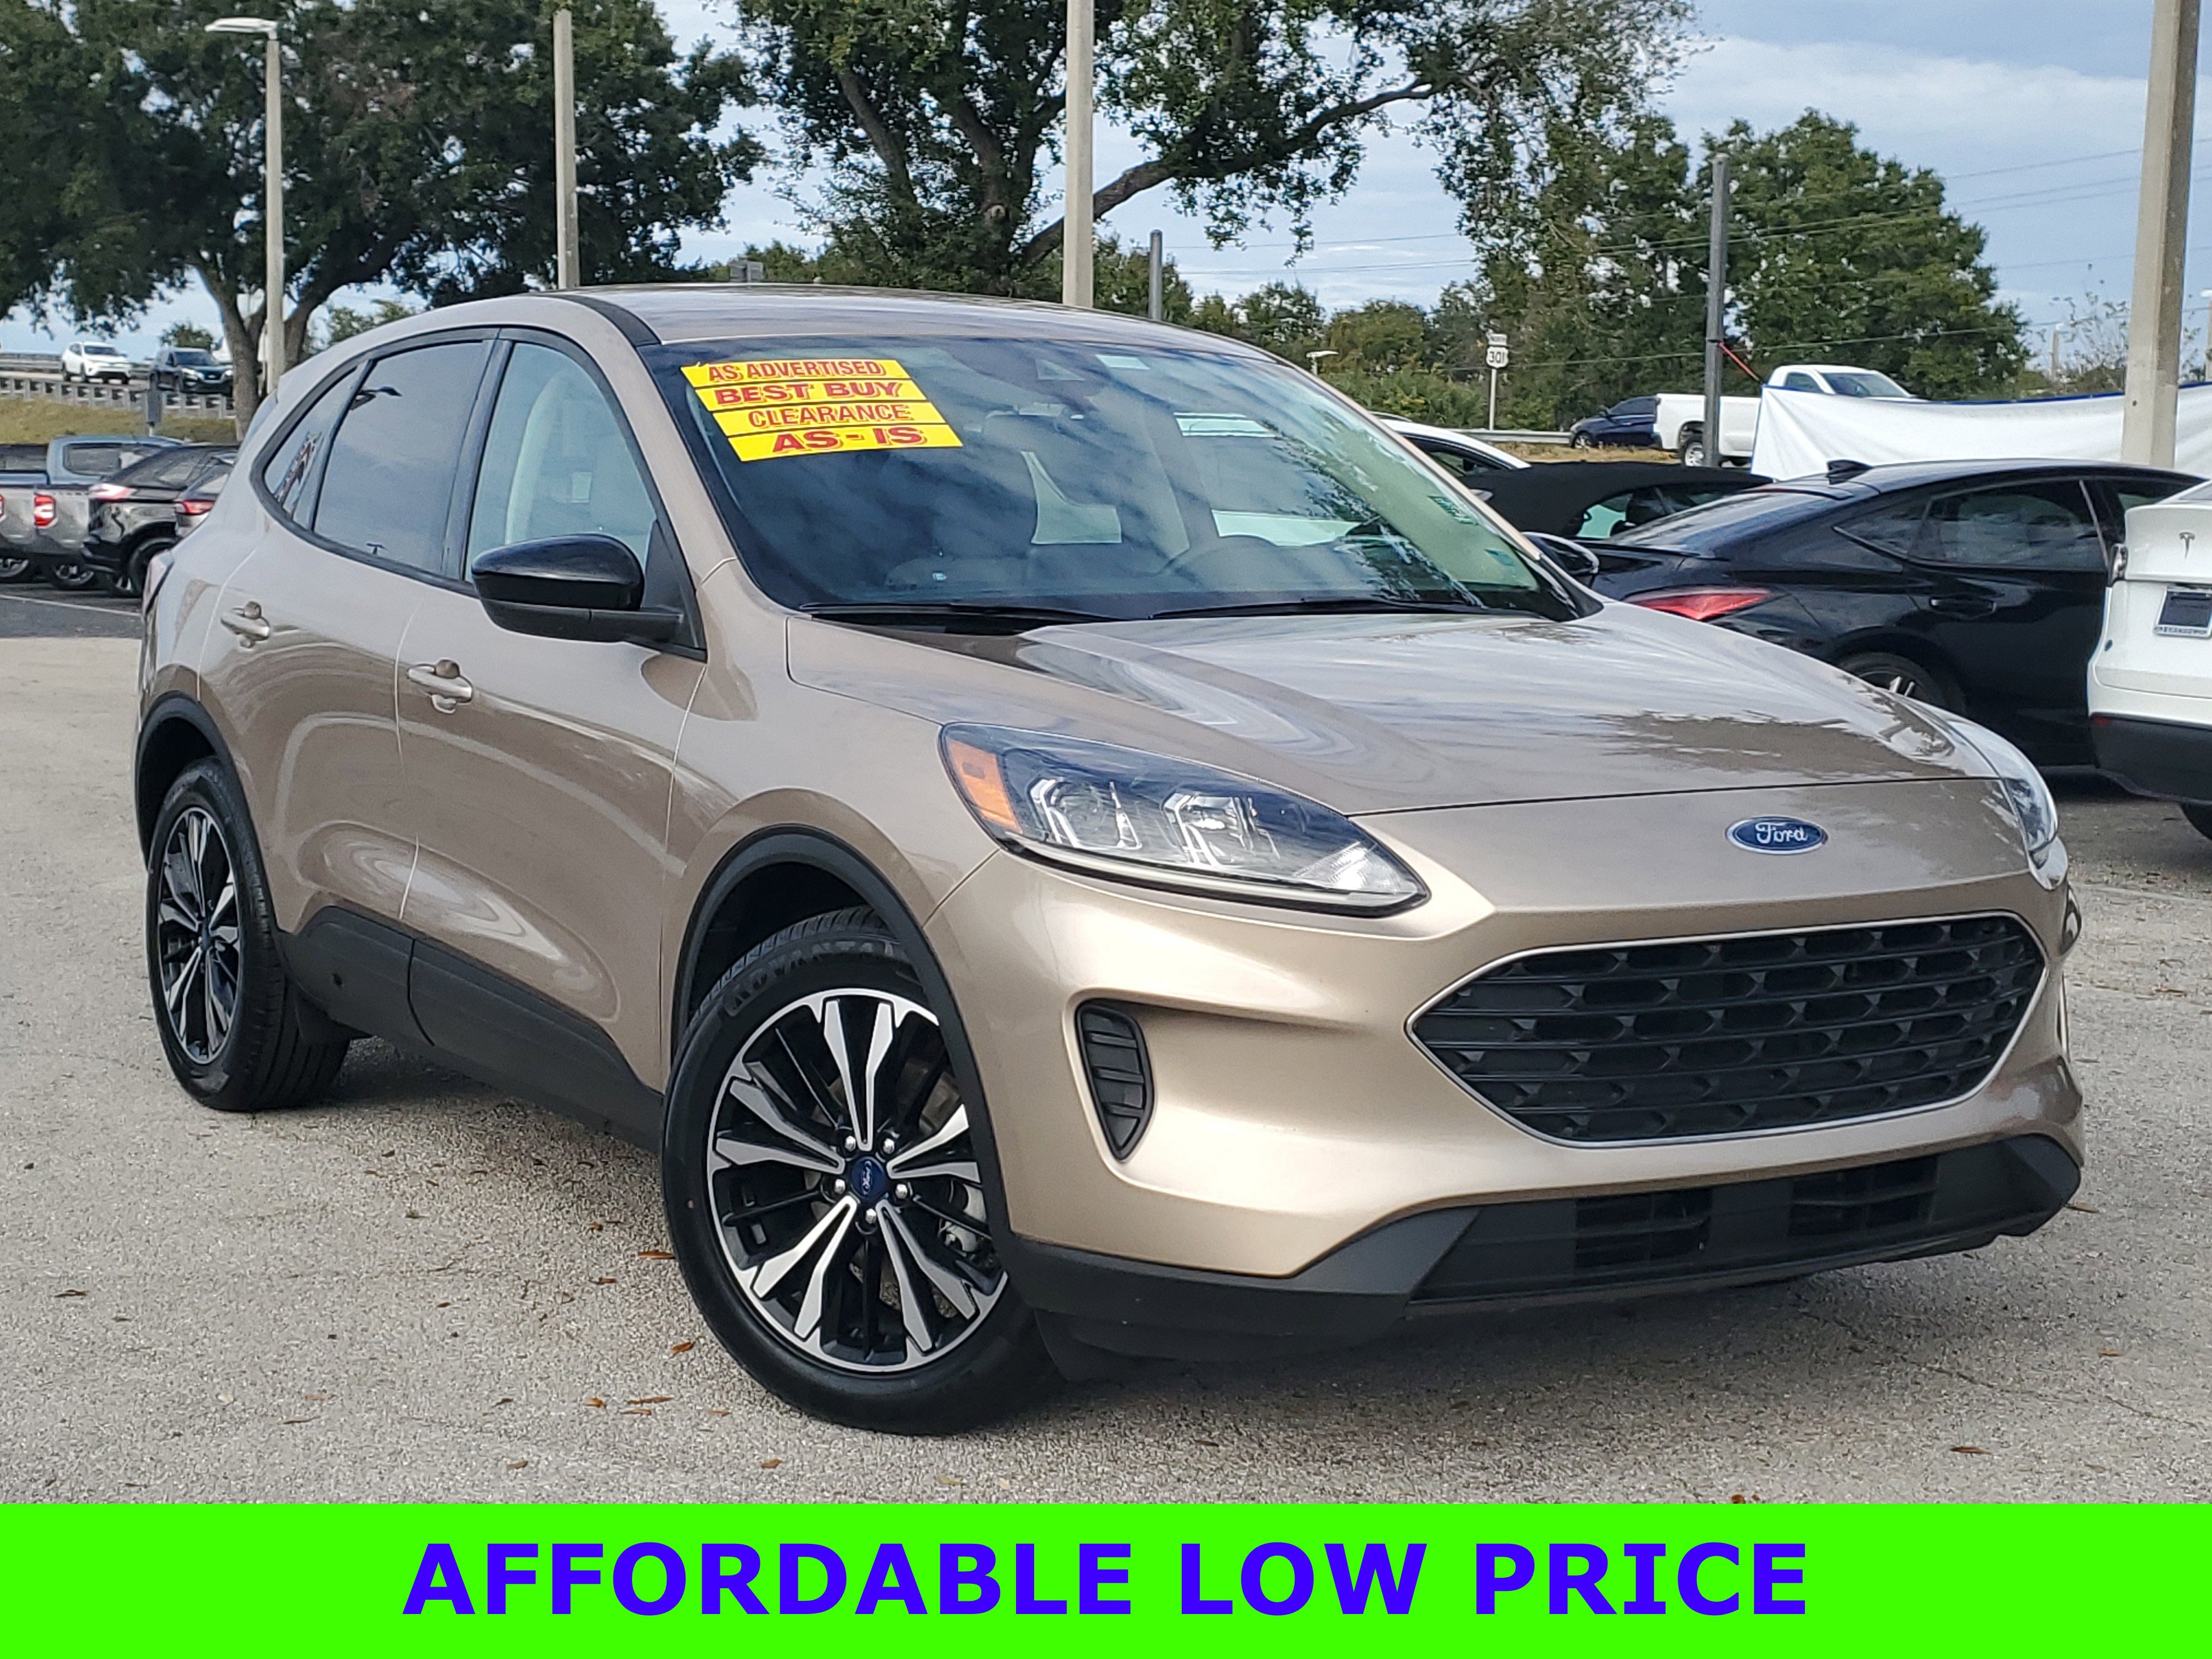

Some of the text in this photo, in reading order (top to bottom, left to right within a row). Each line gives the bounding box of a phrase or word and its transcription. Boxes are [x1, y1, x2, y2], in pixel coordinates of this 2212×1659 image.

[1489, 351, 1505, 363] 301
[709, 360, 887, 382] AS ADVERTISED
[714, 381, 903, 406] BEST BUY
[748, 404, 913, 428] CLEARANCE
[1754, 821, 1808, 844] Ford
